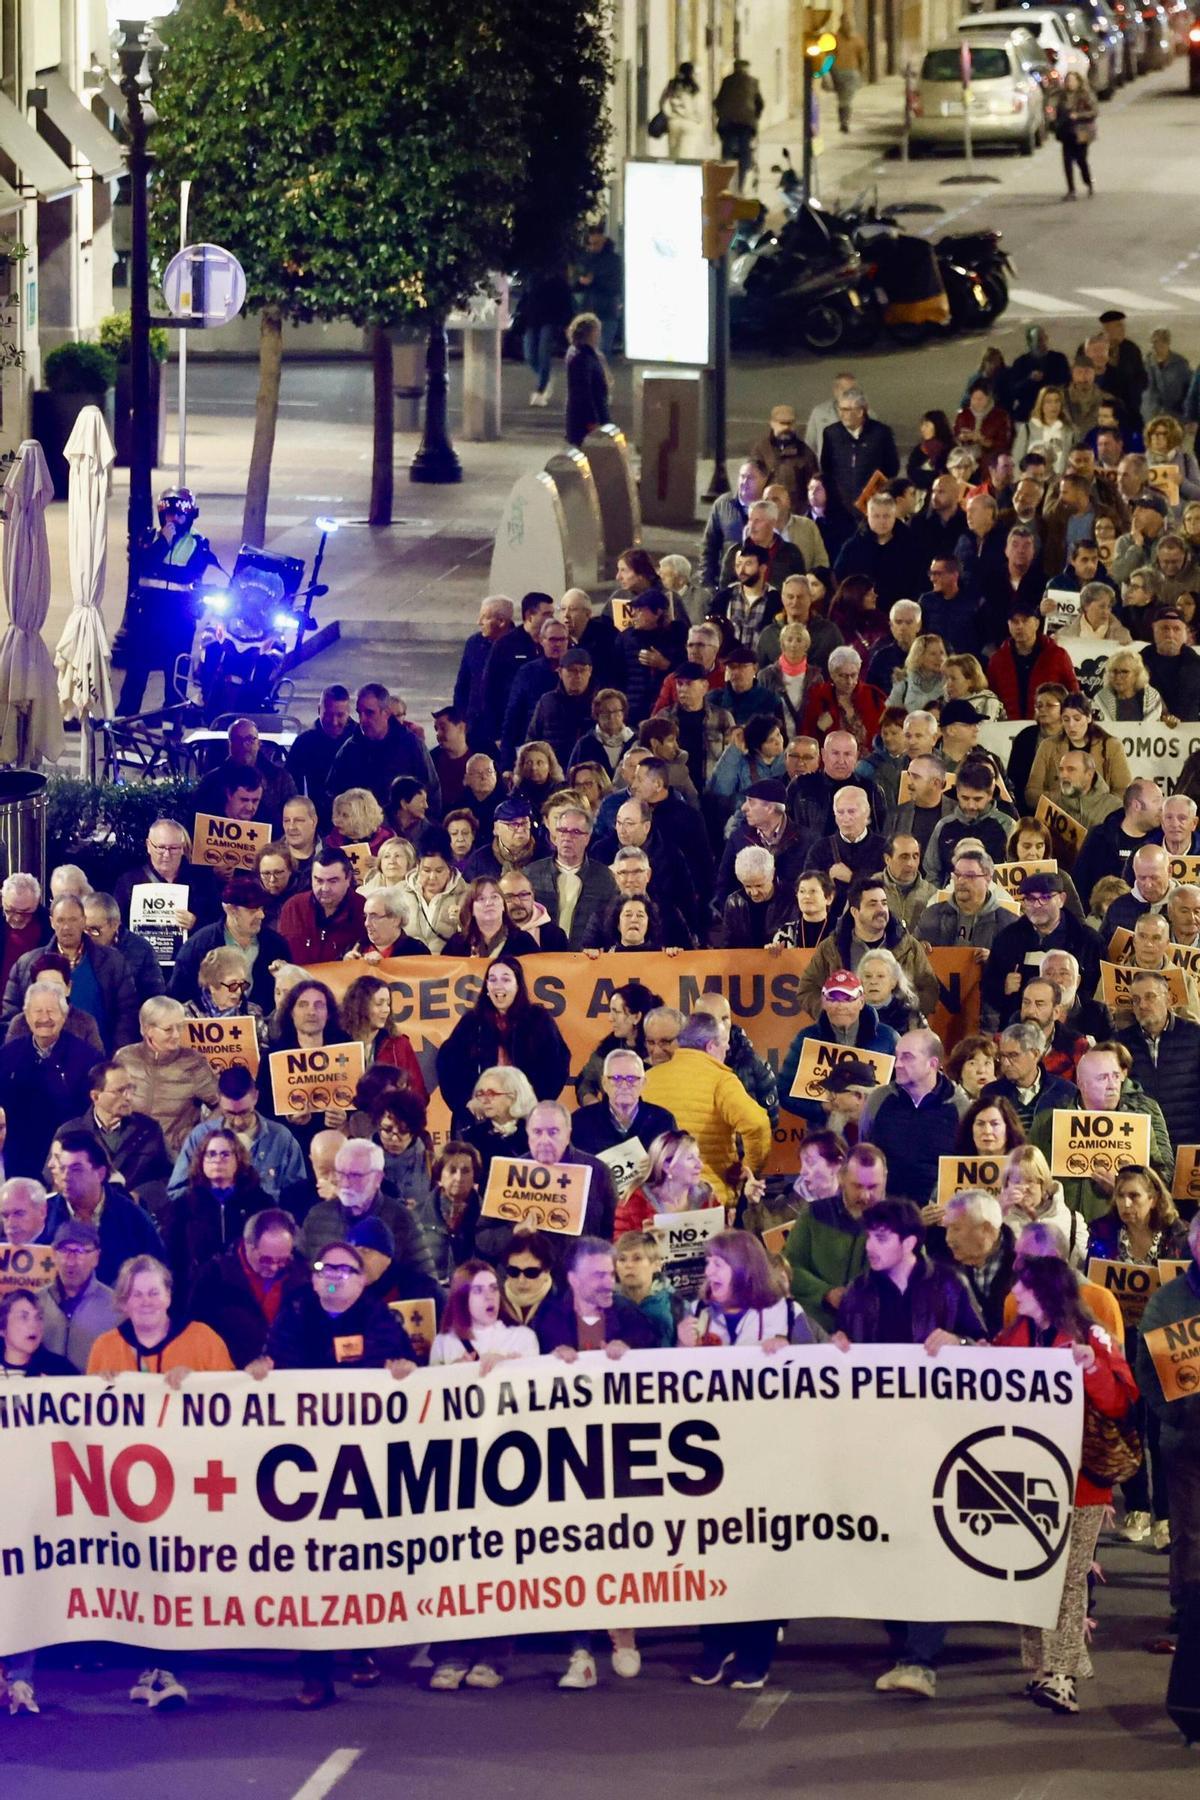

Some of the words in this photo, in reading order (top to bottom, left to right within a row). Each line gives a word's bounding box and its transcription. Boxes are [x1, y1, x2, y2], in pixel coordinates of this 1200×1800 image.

[1122, 736, 1180, 758] OMOS
[208, 819, 242, 840] NO
[206, 838, 256, 851] CAMIONES
[1170, 859, 1187, 879] O
[143, 898, 165, 909] NO
[678, 973, 801, 1018] MUS
[188, 1022, 224, 1043] NO
[287, 1051, 329, 1074] NO
[287, 1073, 348, 1085] CAMIONES
[1070, 1115, 1113, 1138] NO
[1068, 1139, 1132, 1150] CAMIONES
[507, 1164, 551, 1190] NO
[612, 1164, 624, 1178] O
[957, 1161, 999, 1185] NO
[503, 1189, 567, 1203] CAMIONES
[669, 1228, 698, 1243] NO
[1104, 1265, 1151, 1293] NO
[0, 1386, 144, 1429] INACIÓN
[183, 1393, 231, 1427] NO
[242, 1393, 286, 1427] AL
[298, 1390, 408, 1427] RUIDO
[443, 1383, 485, 1422] NO
[498, 1380, 518, 1415] A
[528, 1374, 593, 1412] LAS
[604, 1360, 840, 1405] MERCANCÍAS
[852, 1365, 1073, 1405] PELIGROSAS
[51, 1440, 175, 1524] NO
[194, 1459, 237, 1512] +
[256, 1419, 725, 1523] CAMIONES
[34, 1531, 142, 1571] barrio
[149, 1535, 238, 1574] libre
[249, 1534, 296, 1574] de
[305, 1525, 503, 1576] transporte
[516, 1517, 654, 1565] pesado
[667, 1519, 685, 1557] y
[698, 1507, 890, 1555] peligroso.
[67, 1587, 144, 1624] A.V.V.
[154, 1593, 194, 1627] DE
[204, 1595, 246, 1627] LA
[255, 1590, 408, 1627] CALZADA
[417, 1575, 586, 1618] «ALFONSO
[597, 1563, 729, 1605] CAMÍN»
